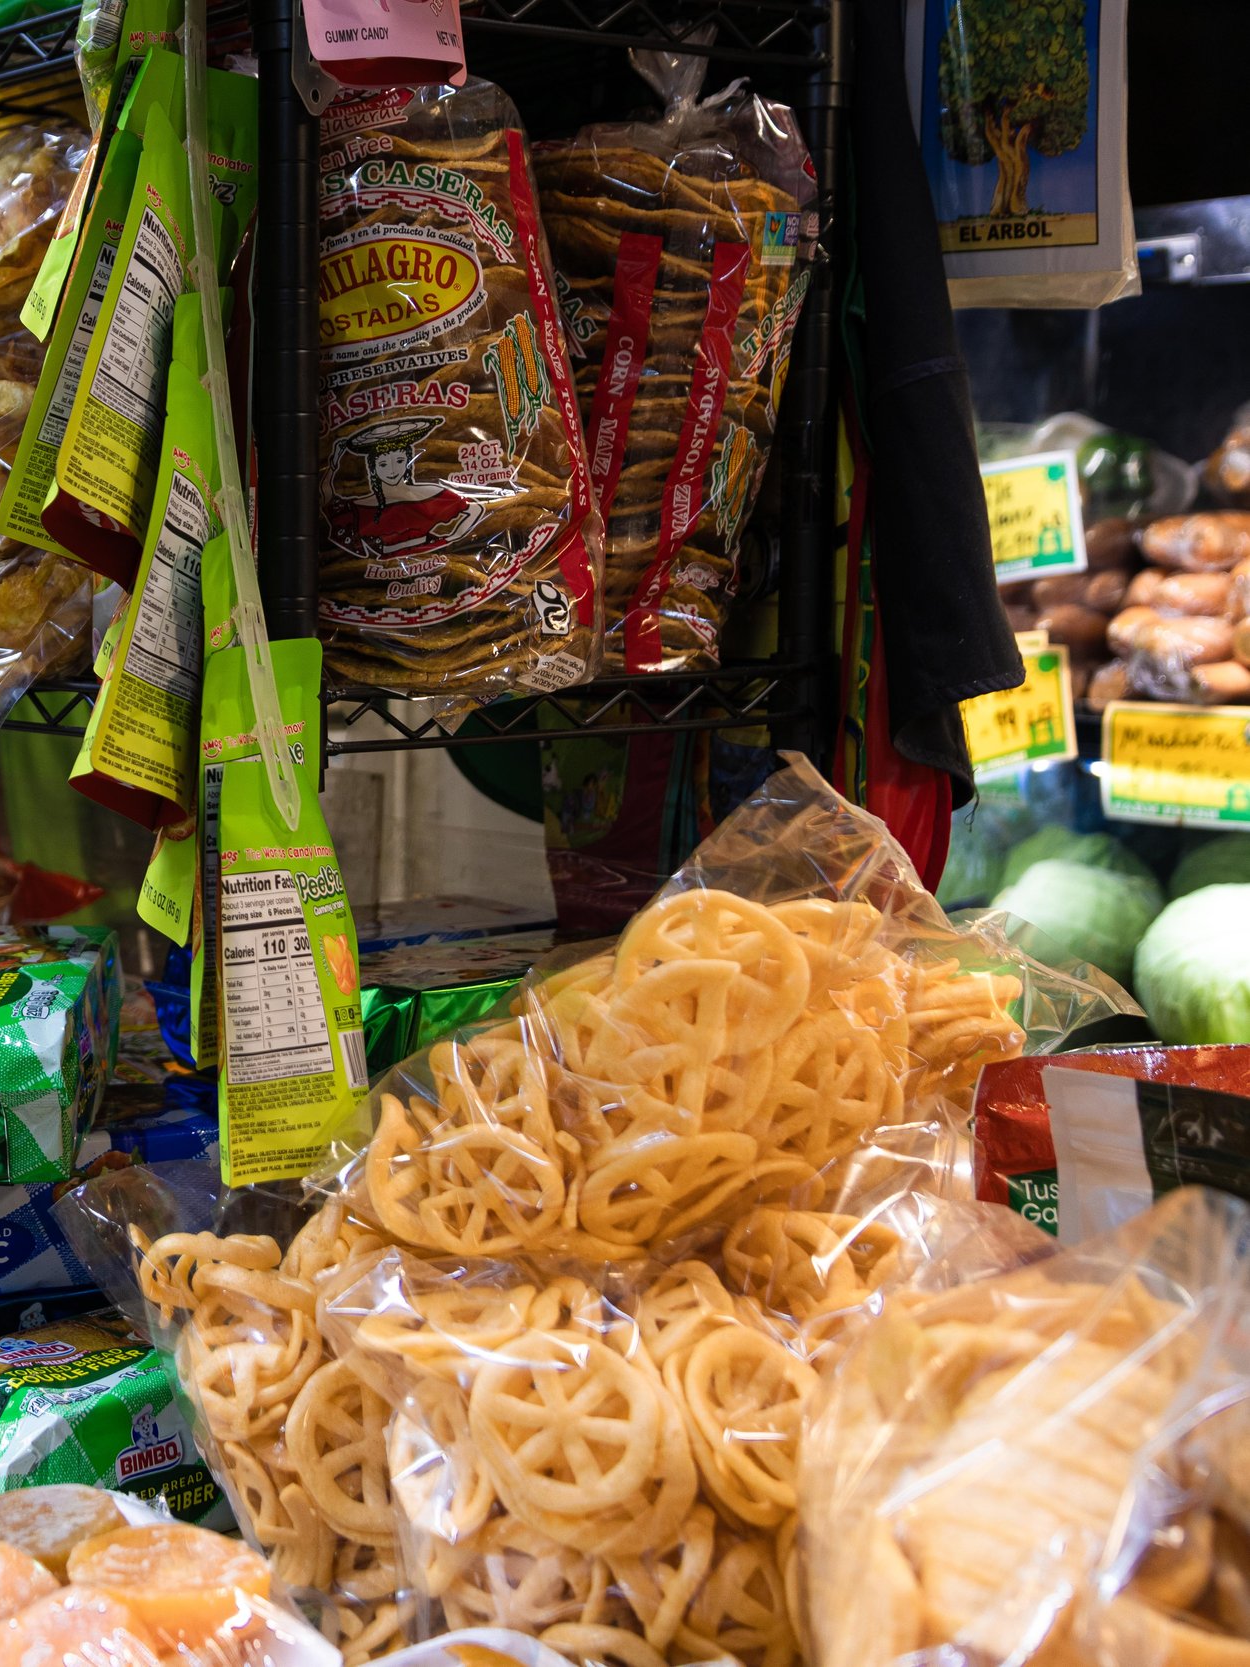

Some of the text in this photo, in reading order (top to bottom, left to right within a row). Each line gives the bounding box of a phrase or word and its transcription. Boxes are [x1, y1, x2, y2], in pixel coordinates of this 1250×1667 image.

[325, 27, 389, 43] GUMMY CANDY
[436, 30, 450, 45] NET
[376, 92, 400, 109] you
[347, 136, 392, 162] Free
[208, 152, 253, 173] nnovator
[361, 161, 513, 245] CASERAS
[357, 230, 369, 238] en
[372, 225, 380, 235] el
[383, 226, 424, 238] producto
[427, 228, 436, 238] la
[959, 225, 981, 242] EL
[127, 272, 152, 299] Calories
[320, 293, 440, 340] OSTADAS
[740, 271, 811, 357] TOSTAD
[336, 350, 360, 360] name
[363, 346, 379, 356] and
[382, 342, 396, 351] the
[400, 330, 430, 349] quality
[432, 325, 440, 335] in
[443, 316, 456, 329] the
[328, 349, 468, 386] PRESERVATIVES
[528, 234, 548, 297] CORN
[561, 390, 587, 507] TOSTADAS
[592, 335, 634, 476] CORN MAIZ
[680, 367, 720, 477] TOSTADAS
[461, 442, 501, 459] 24 CT.
[464, 457, 500, 471] 14 OZ.
[450, 468, 516, 484] (397 grams)
[670, 483, 691, 541] MAIZ
[184, 556, 201, 577] 110
[366, 555, 448, 579] Homemade
[387, 575, 441, 598] Quality
[288, 846, 313, 860] Candy
[222, 877, 271, 895] Nutrition
[157, 893, 166, 910] OZ
[166, 898, 175, 916] (85
[222, 912, 248, 922] Serving
[251, 909, 262, 917] size
[274, 906, 292, 915] Pieces
[245, 899, 265, 909] servings
[266, 899, 275, 907] per
[224, 936, 310, 960] Calories 110 300
[4, 1348, 122, 1378] TOASTED BREAD
[8, 1369, 89, 1389] DOUBLE
[88, 1349, 145, 1371] FIBER
[120, 1441, 178, 1476] BIMBO
[163, 1471, 203, 1493] BREAD
[167, 1483, 215, 1512] FIBER
